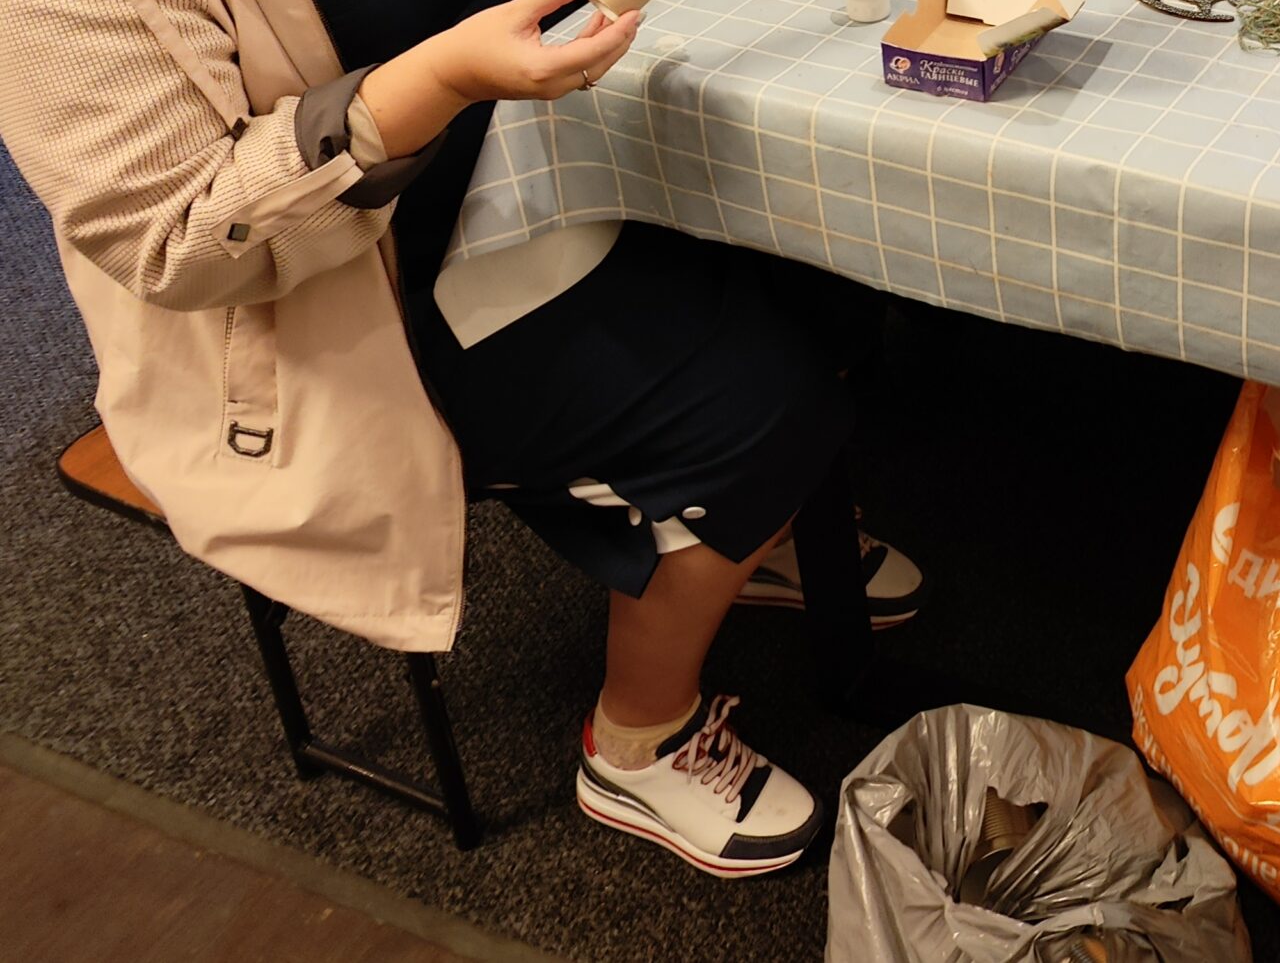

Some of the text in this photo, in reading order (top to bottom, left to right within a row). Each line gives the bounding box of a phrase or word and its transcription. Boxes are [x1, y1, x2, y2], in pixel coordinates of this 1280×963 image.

[919, 59, 965, 77] Краски
[887, 72, 920, 85] АКРИЛ
[920, 71, 979, 88] ГЛЯНЦЕВЫЕ
